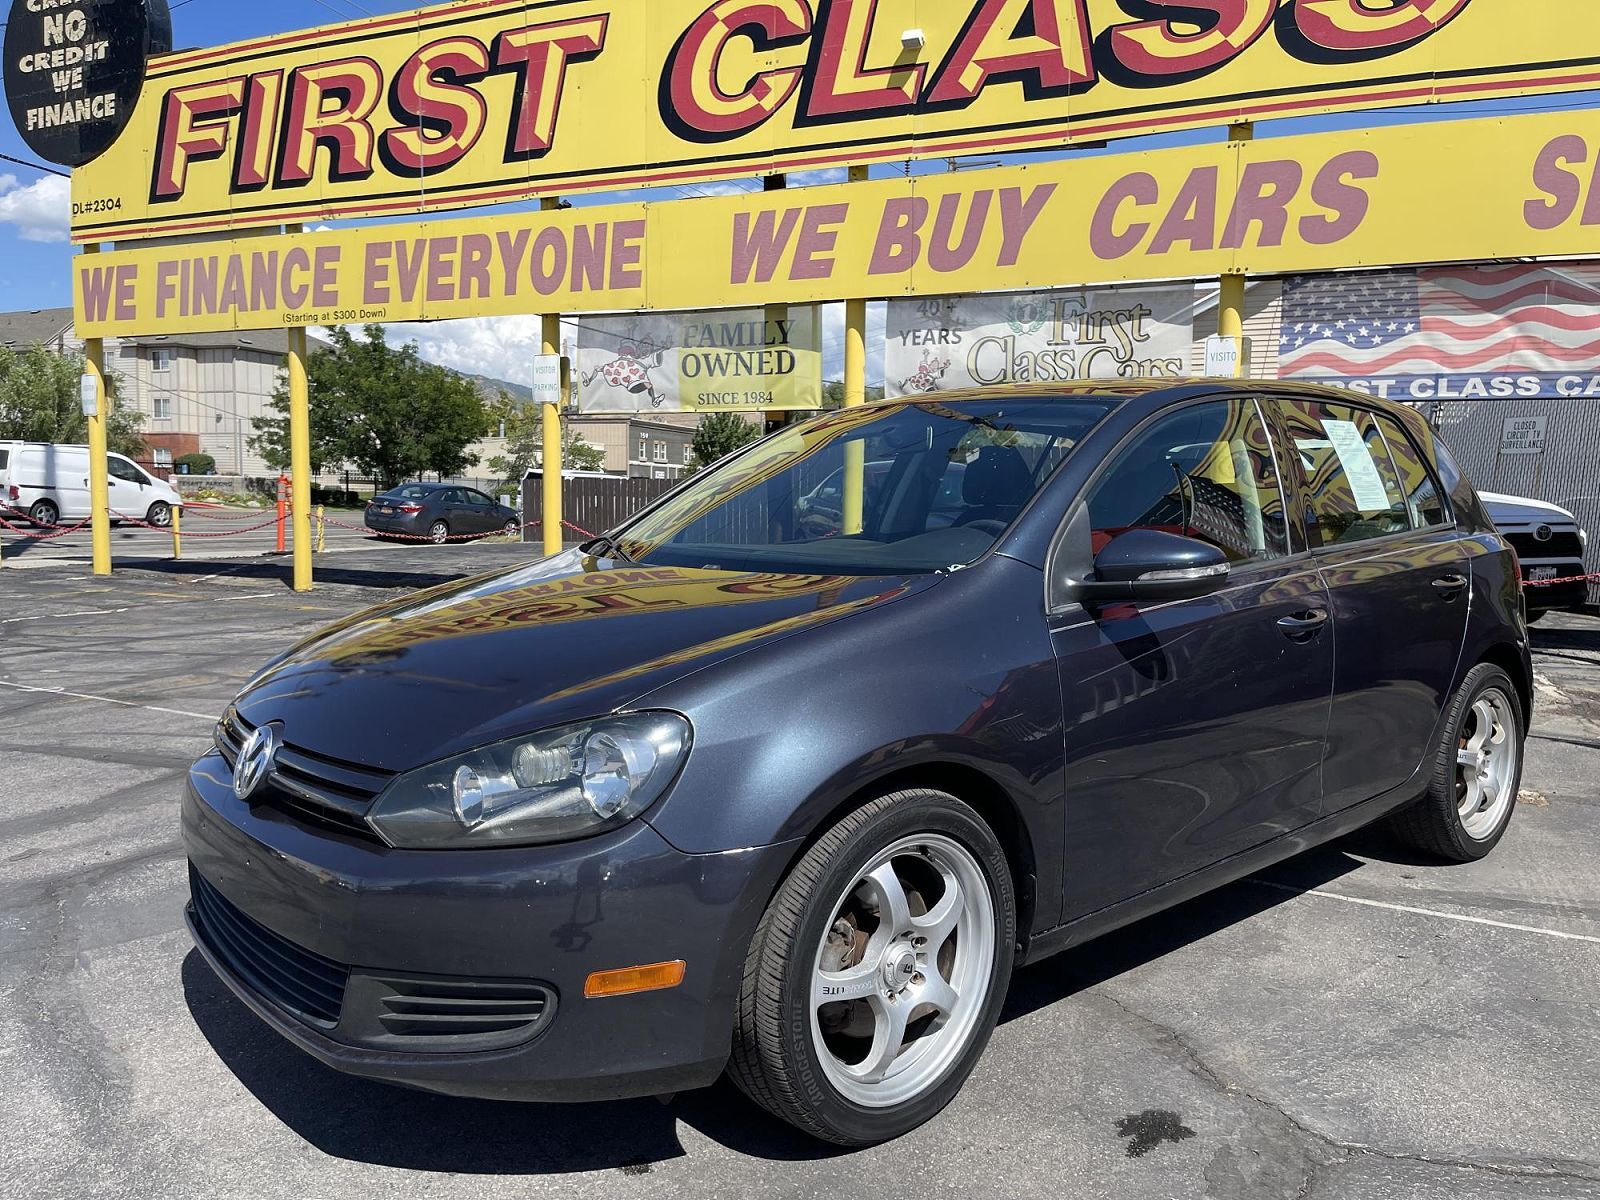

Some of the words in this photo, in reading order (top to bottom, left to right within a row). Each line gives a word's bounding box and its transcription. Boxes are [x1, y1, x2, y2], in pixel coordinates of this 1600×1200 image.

[43, 10, 87, 47] NO
[19, 41, 109, 73] CREDIT
[52, 67, 83, 93] WE
[26, 93, 116, 131] FINANCE
[149, 12, 609, 204] FIRST
[72, 198, 122, 215] DL#2304
[730, 203, 850, 285] WE
[867, 183, 1058, 276] BUY
[1089, 150, 1379, 260] CARS
[80, 264, 138, 322] WE
[156, 246, 341, 318] FINANCE
[363, 220, 646, 305] EVERYONE
[282, 312, 318, 323] (Starting
[321, 312, 330, 320] at
[333, 310, 356, 320] $300
[360, 308, 386, 319] Down)
[682, 319, 795, 348] FAMILY
[900, 328, 962, 346] YEARS
[1047, 296, 1152, 363] First
[535, 365, 556, 374] VISITOR
[681, 349, 796, 378] OWNED
[967, 334, 1075, 385] Class
[534, 383, 558, 391] PARKING
[698, 393, 739, 406] SINCE
[743, 391, 774, 405] 1984
[1409, 375, 1541, 398] CLASS
[1506, 430, 1529, 440] CIRCUIT
[1533, 430, 1541, 439] TV
[1513, 420, 1537, 430] CLOSED
[1501, 440, 1544, 449] SURVEILLANCE
